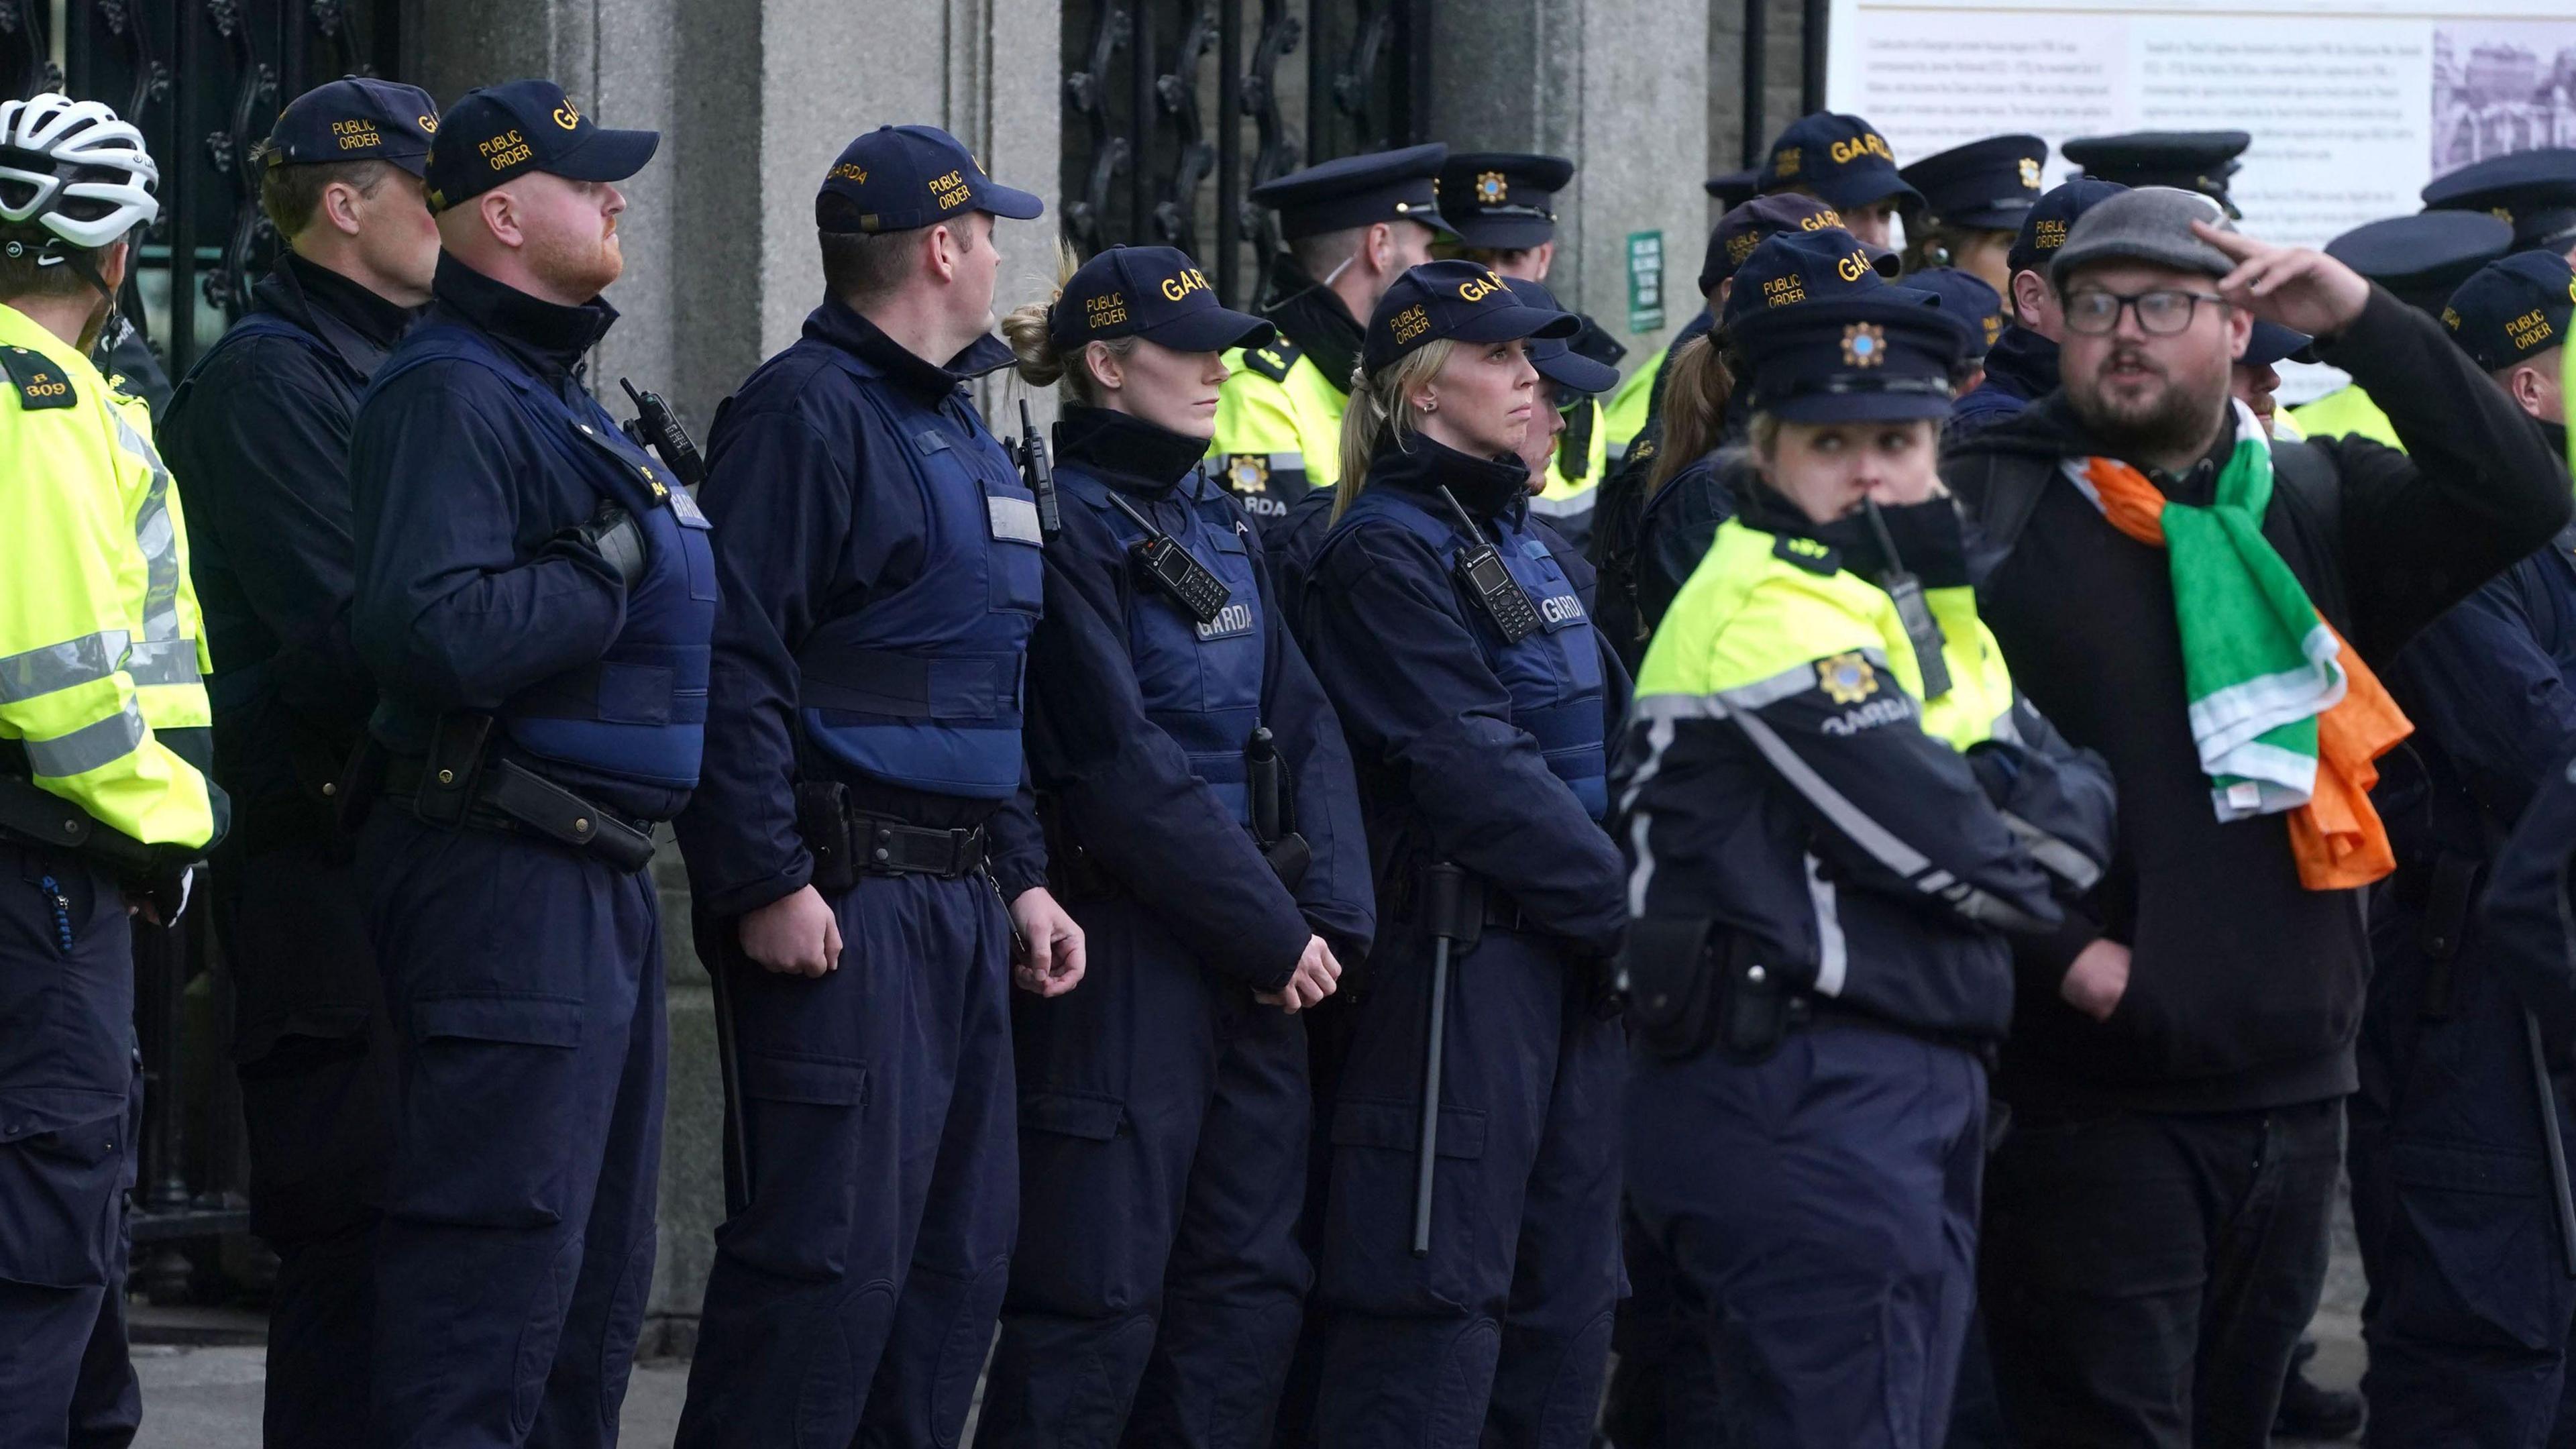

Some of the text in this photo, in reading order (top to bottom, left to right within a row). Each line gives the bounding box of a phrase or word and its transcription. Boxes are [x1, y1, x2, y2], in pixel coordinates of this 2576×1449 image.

[332, 119, 376, 135] PUBLIC
[339, 133, 381, 150] ORDER
[478, 129, 522, 157] PUBLIC
[490, 144, 533, 170] ORDER
[928, 170, 963, 195] PUBLIC
[938, 184, 971, 210] ORDER
[2036, 220, 2067, 233] PUBLIC
[2035, 233, 2066, 249] ORDER
[1838, 248, 1874, 282] GAR
[1161, 268, 1212, 301] GAR
[1458, 270, 1513, 302] GAR
[1763, 273, 1802, 296] PUBLIC
[1086, 291, 1124, 313] PUBLIC
[1768, 288, 1806, 309] ORDER
[1089, 307, 1128, 329] ORDER
[1390, 304, 1426, 331] PUBLIC
[2505, 309, 2544, 337] PUBLIC
[1395, 315, 1431, 345] ORDER
[2515, 322, 2553, 350] ORDER
[26, 382, 66, 397] 309
[34, 374, 48, 384] B
[1245, 496, 1287, 517] RDA
